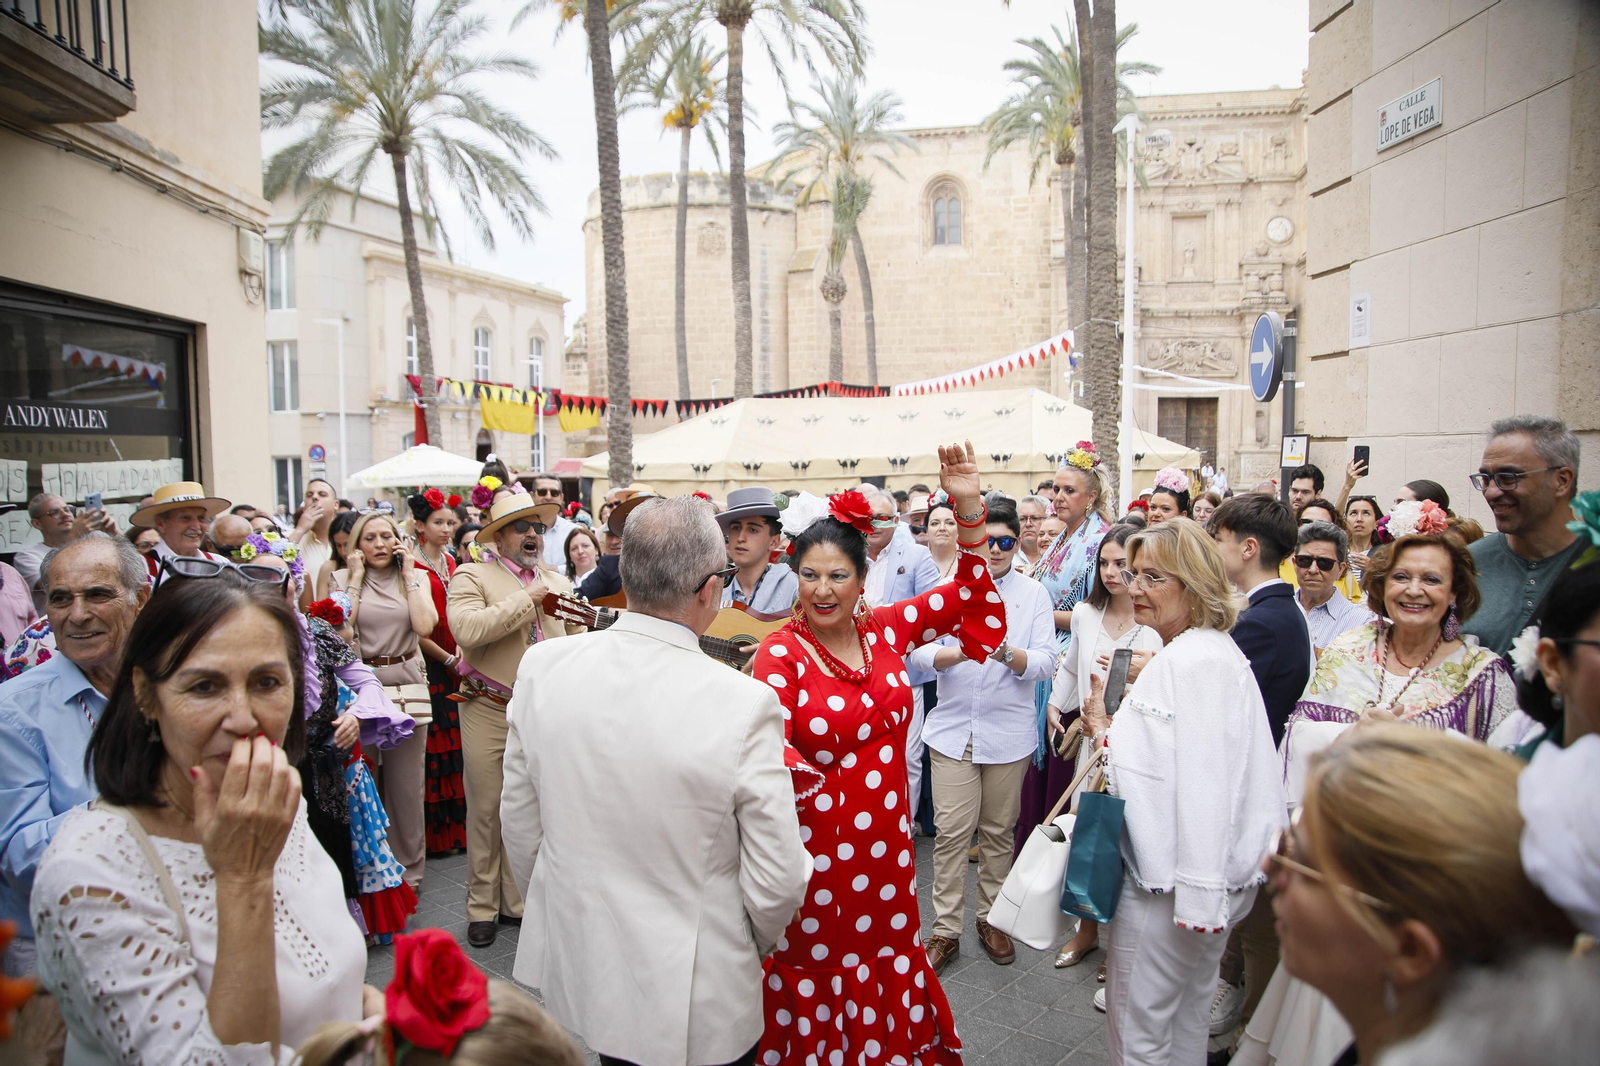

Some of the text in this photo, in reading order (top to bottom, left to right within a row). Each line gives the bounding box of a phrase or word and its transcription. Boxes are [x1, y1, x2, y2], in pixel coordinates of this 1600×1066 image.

[1399, 90, 1426, 111] CALLE
[1380, 105, 1435, 145] LOPE DE VEGA
